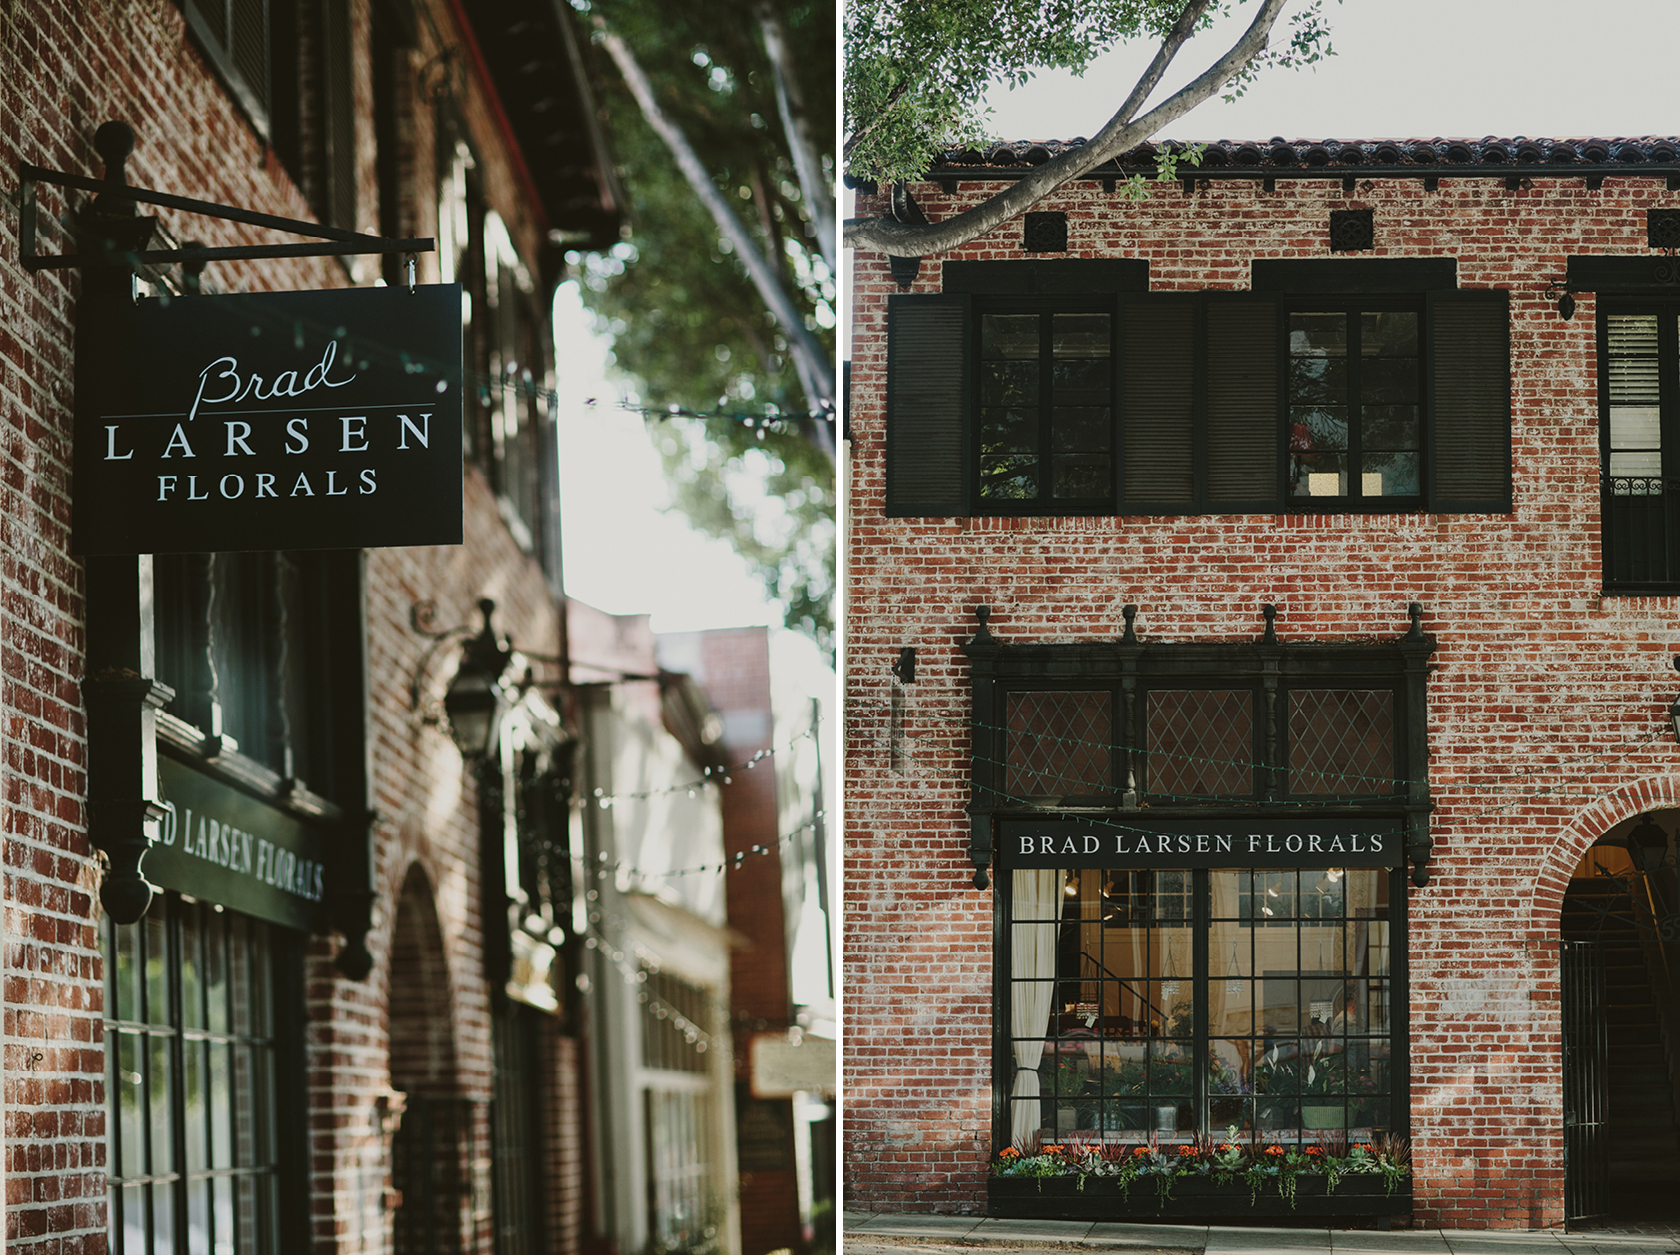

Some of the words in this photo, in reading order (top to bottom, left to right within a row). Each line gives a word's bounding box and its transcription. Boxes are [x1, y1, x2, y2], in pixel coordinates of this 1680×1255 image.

[189, 340, 356, 421] Brad
[103, 413, 433, 460] LARSEN
[157, 468, 378, 501] FLORALS
[184, 809, 254, 874] LARSEN
[256, 839, 324, 901] FLORALS
[1019, 834, 1100, 855] BRAD
[1115, 834, 1232, 854] LARSEN
[1248, 833, 1384, 854] FLORALS
